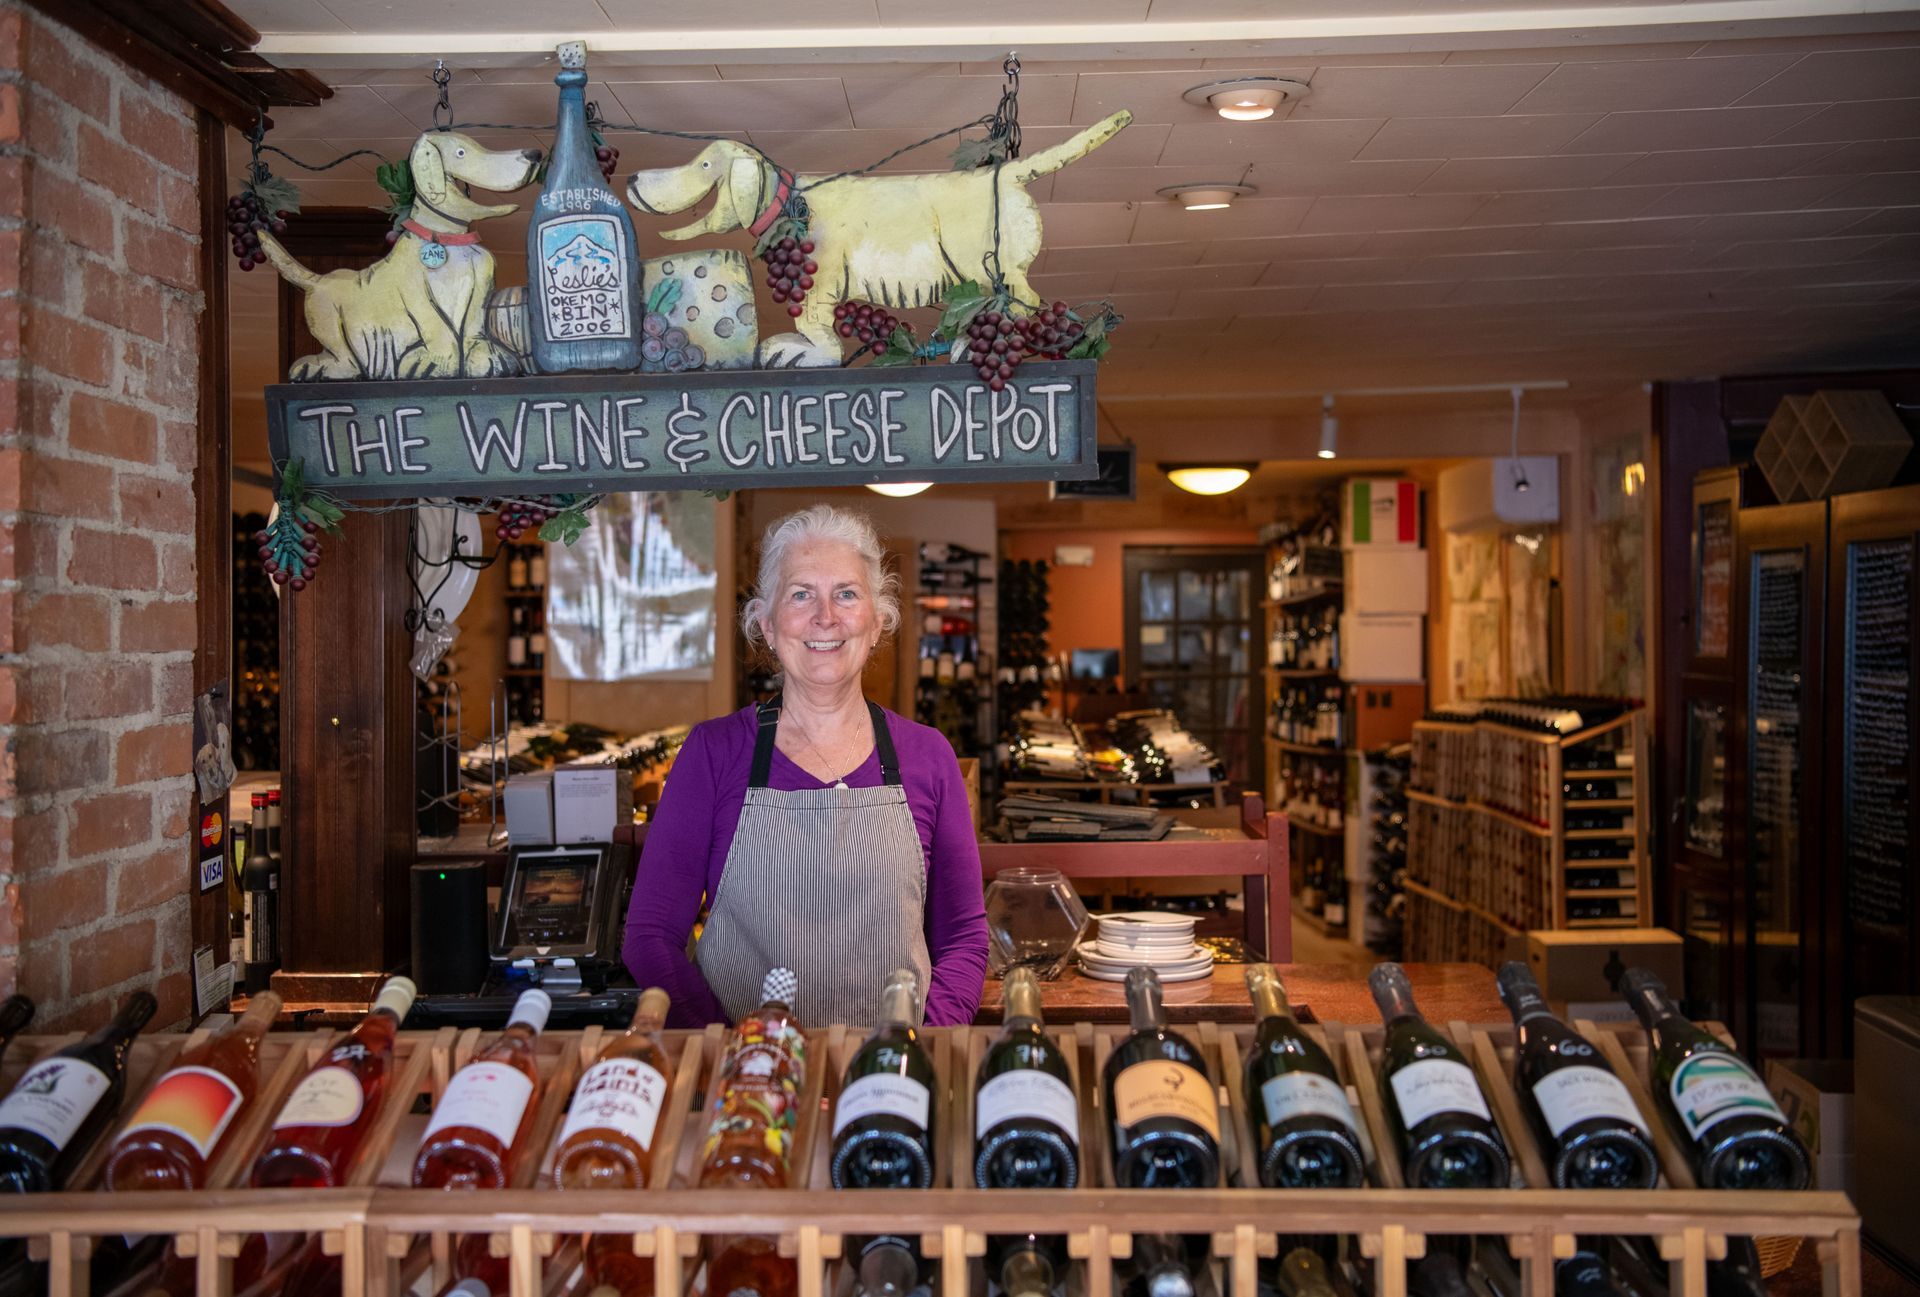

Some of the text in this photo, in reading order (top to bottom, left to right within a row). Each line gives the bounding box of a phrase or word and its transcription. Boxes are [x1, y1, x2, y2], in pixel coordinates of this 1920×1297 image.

[541, 187, 621, 208] ESTABLISHED
[559, 200, 592, 213] 1996
[547, 264, 620, 294] Leslie's
[551, 293, 608, 307] OKEMO
[561, 305, 609, 322] BIN
[560, 319, 611, 336] 2006
[300, 383, 1073, 473] THE WINE & CHEESE DEPOT
[203, 861, 222, 883] VISA
[1558, 1038, 1593, 1056] 60
